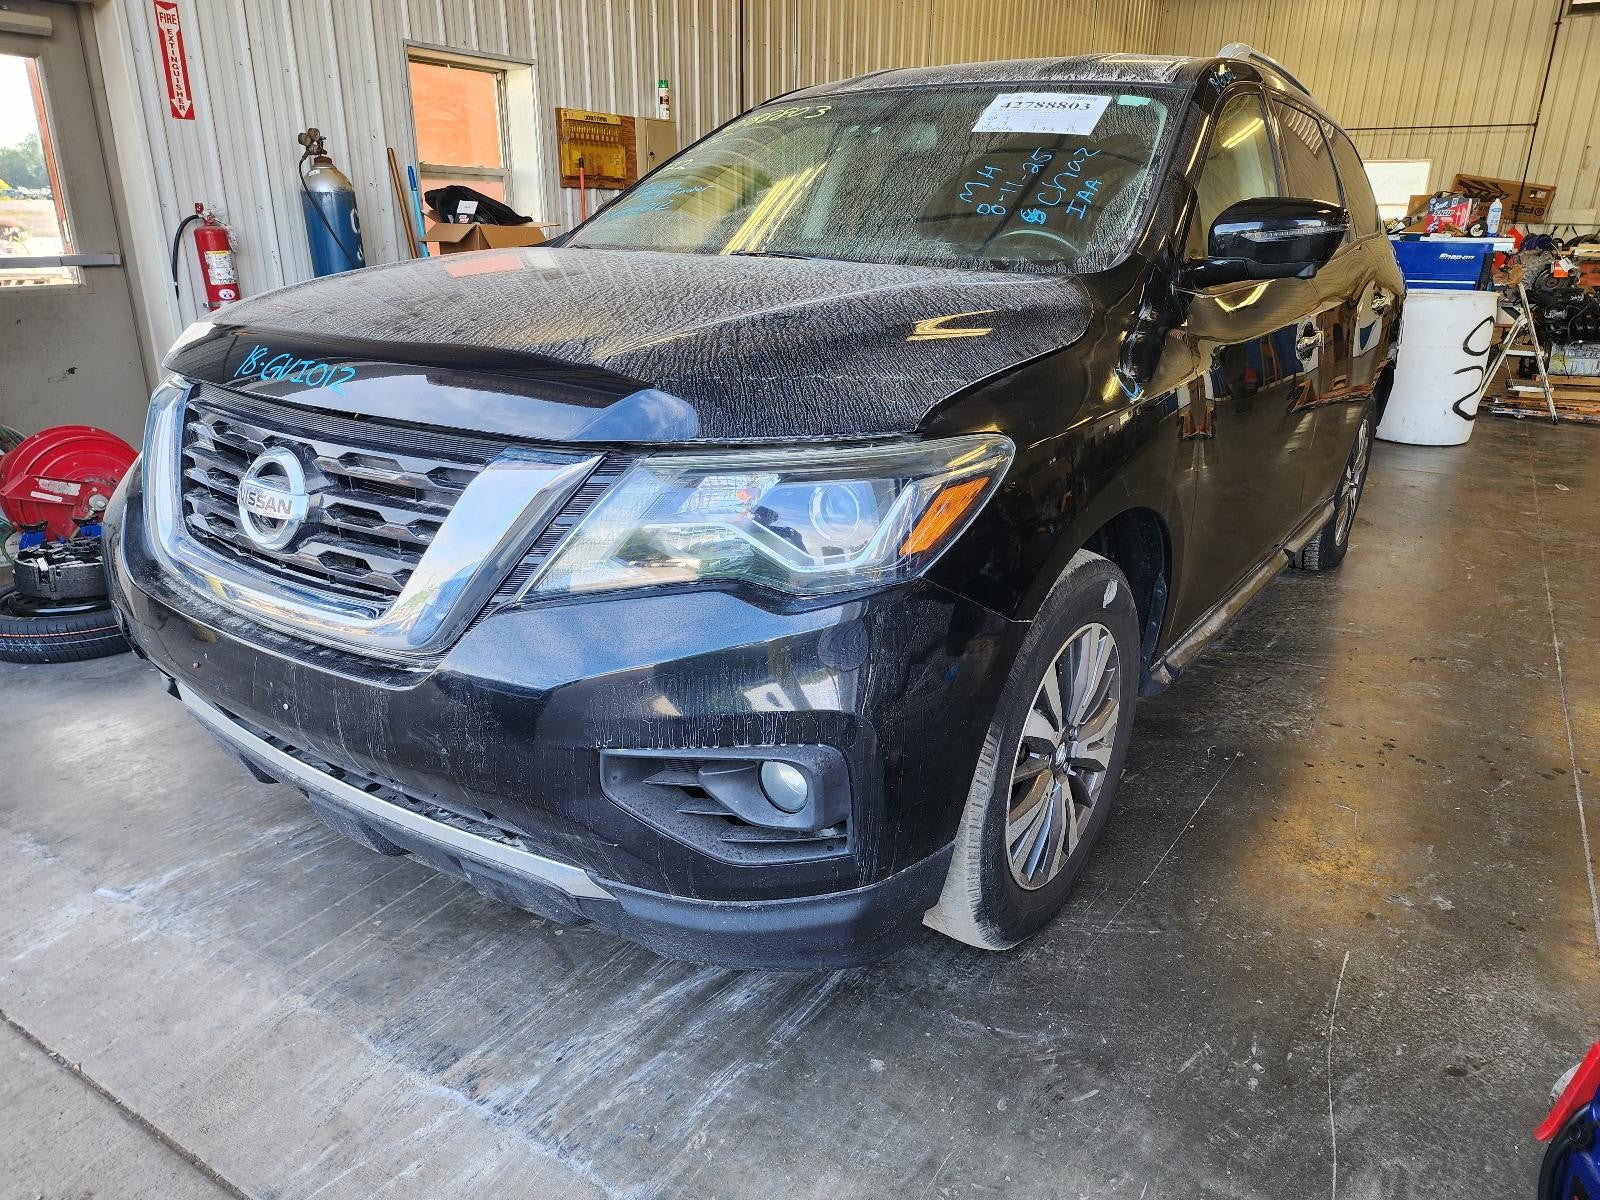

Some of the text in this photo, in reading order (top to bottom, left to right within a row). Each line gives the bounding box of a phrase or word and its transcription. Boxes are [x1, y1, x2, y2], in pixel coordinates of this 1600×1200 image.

[160, 12, 177, 25] FIRE
[166, 28, 186, 111] EXTINGUISHER
[1000, 101, 1091, 111] 42788803
[1065, 179, 1103, 220] IAA
[239, 484, 294, 514] NISSAN
